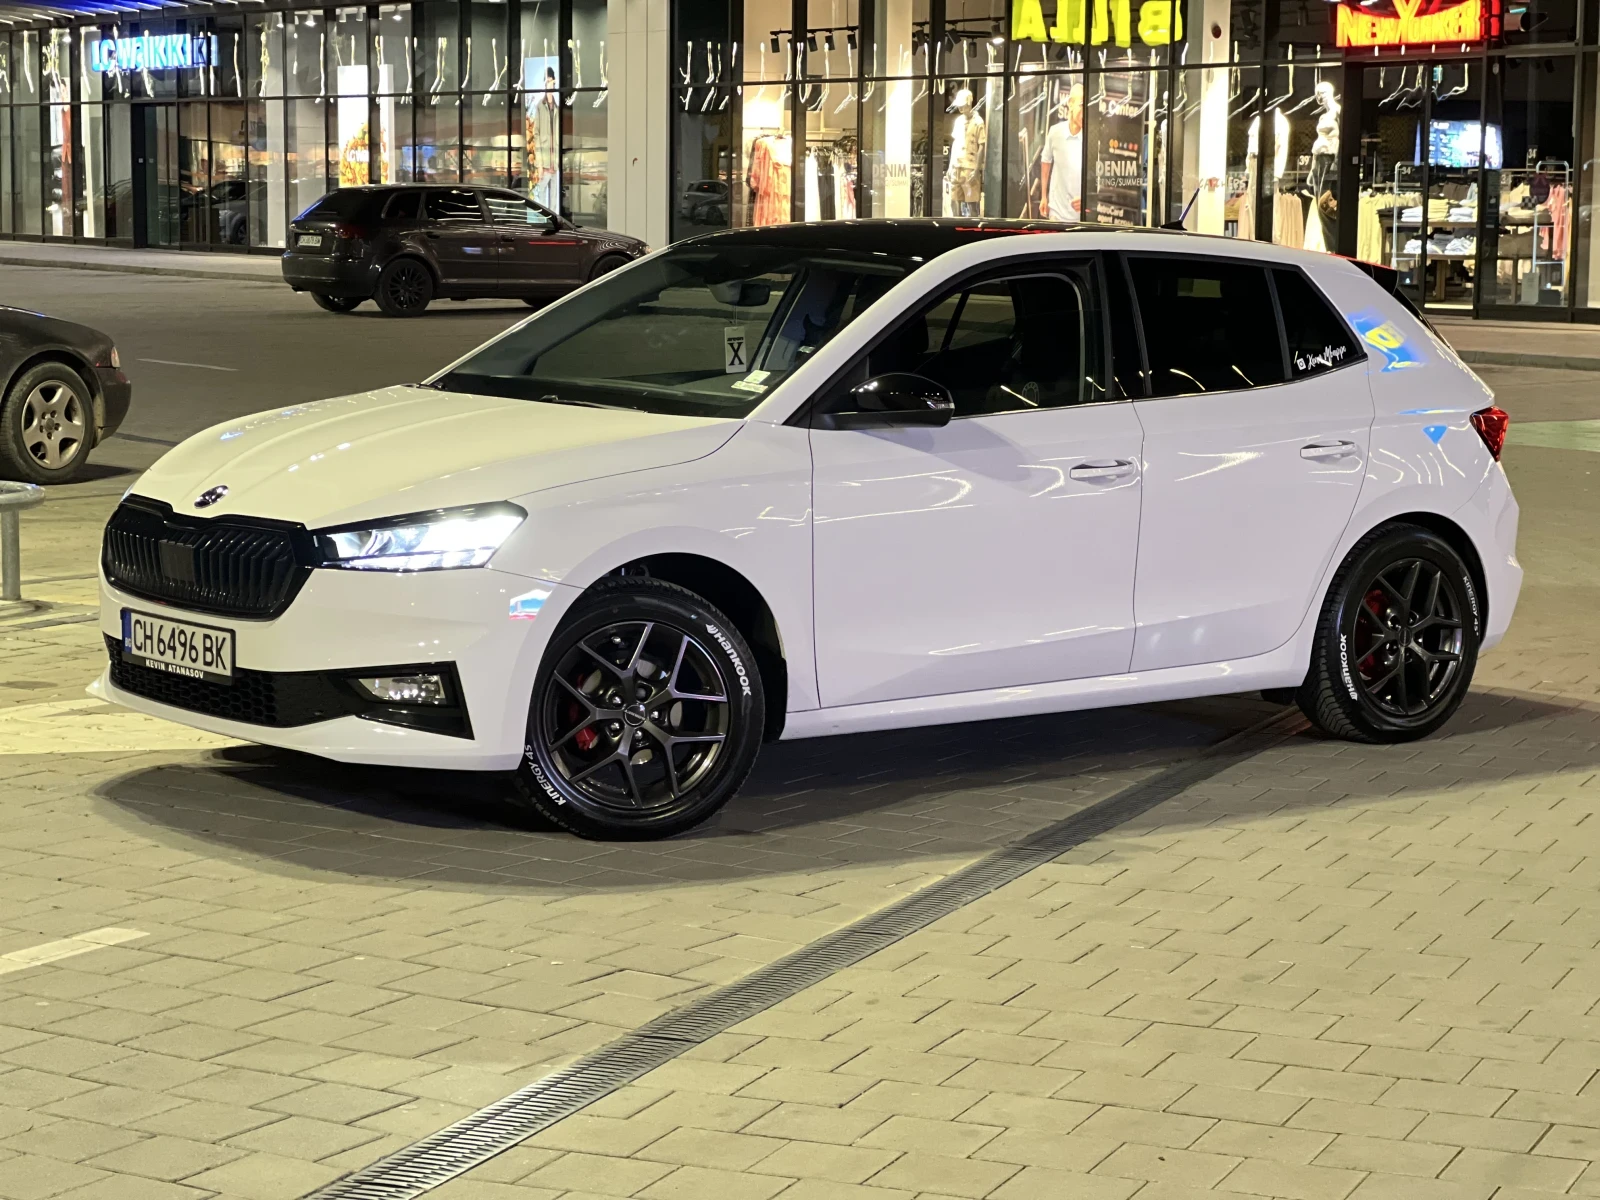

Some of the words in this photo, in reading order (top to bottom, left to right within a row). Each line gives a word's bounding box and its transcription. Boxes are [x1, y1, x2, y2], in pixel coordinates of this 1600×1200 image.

[872, 164, 908, 178] DENIM
[1095, 160, 1138, 177] DENIM
[1095, 178, 1143, 188] SRING/SUMMER
[727, 341, 745, 366] X
[133, 618, 154, 655] CH
[156, 624, 199, 664] 6496
[202, 633, 227, 671] BK
[145, 658, 166, 671] KEVIN
[168, 664, 204, 679] ATANASOV
